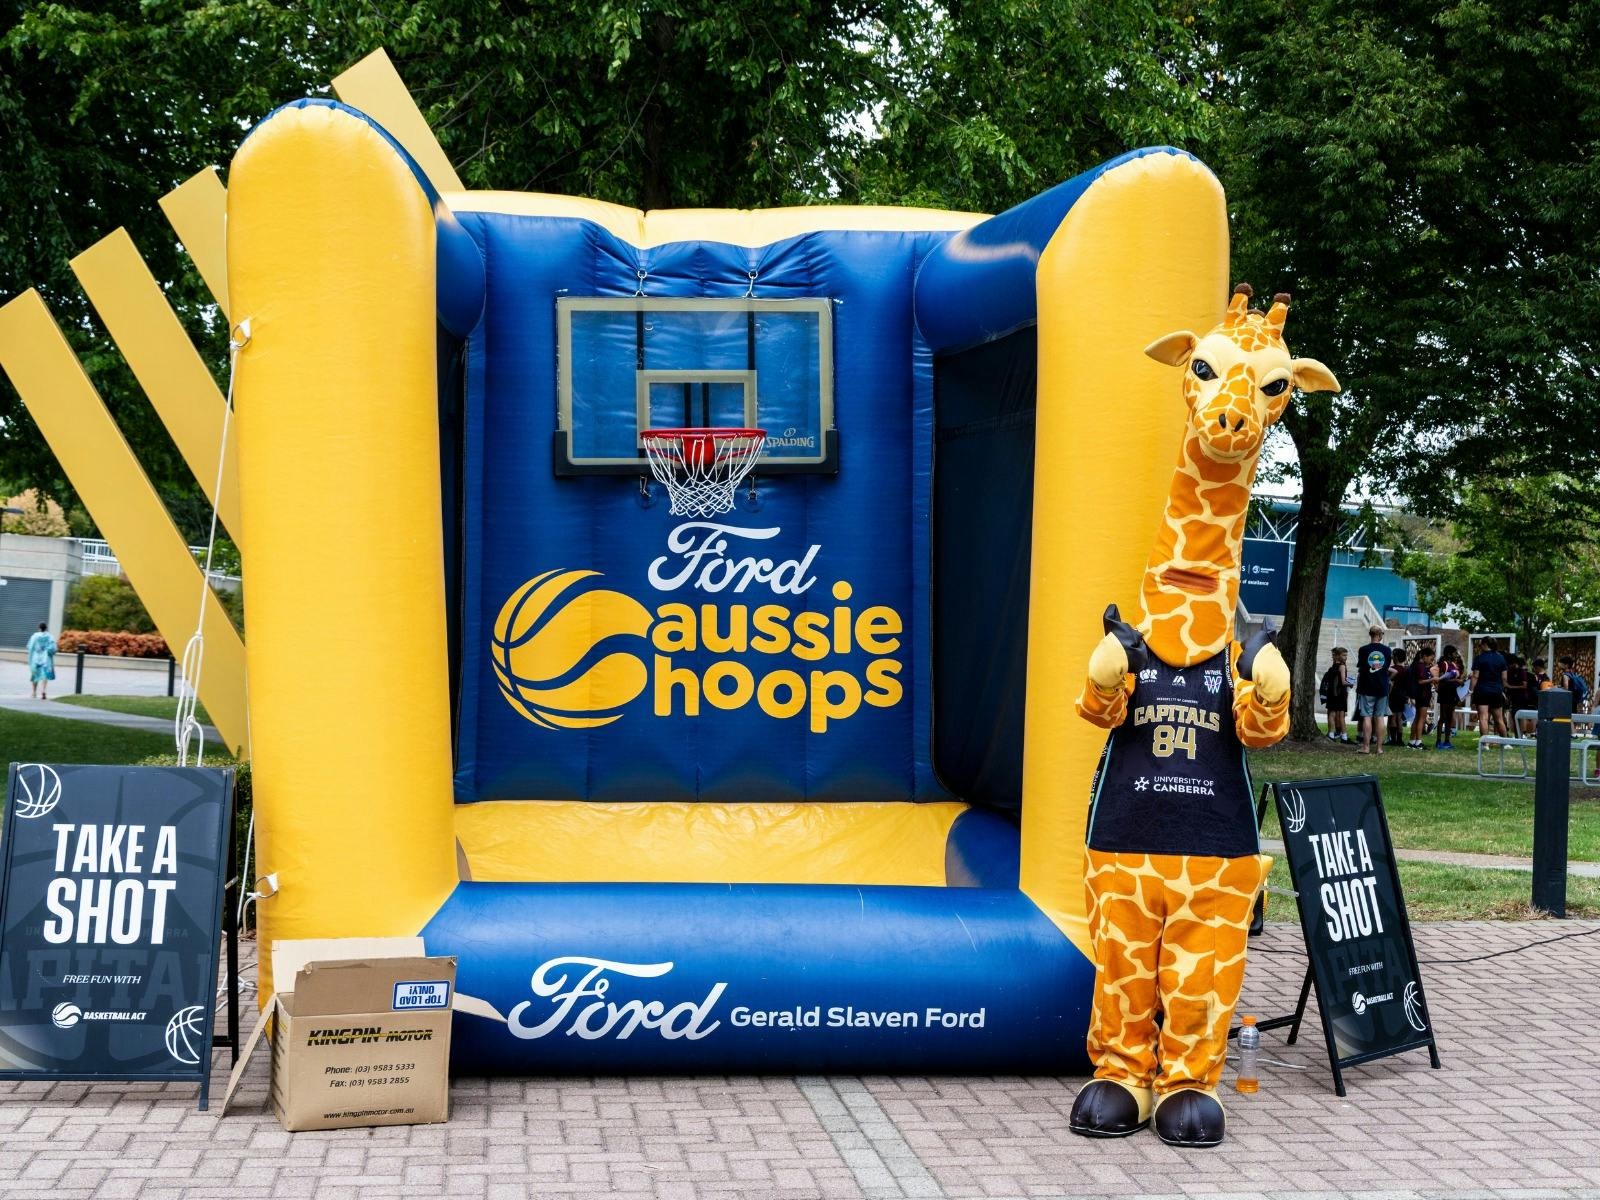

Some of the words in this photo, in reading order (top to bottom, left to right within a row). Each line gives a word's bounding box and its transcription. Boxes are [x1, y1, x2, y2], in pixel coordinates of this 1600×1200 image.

[766, 436, 815, 448] SPALDING
[647, 521, 822, 595] Ford
[651, 580, 904, 661] aussie
[653, 653, 903, 734] hoops
[1134, 704, 1220, 732] CAPITALS
[1152, 724, 1197, 760] 84
[1153, 776, 1202, 785] UNIVERSITY
[1203, 779, 1214, 787] OF
[1153, 783, 1215, 796] CANBERRA
[53, 823, 146, 874] TAKE
[152, 825, 177, 874] A
[1308, 831, 1359, 879] TAKE
[1356, 829, 1374, 872] A
[43, 878, 177, 945] SHOT
[1320, 876, 1385, 942] SHOT
[1348, 966, 1361, 976] FREE
[62, 975, 90, 984] FREE
[90, 975, 113, 984] FUN
[113, 975, 141, 984] WITH
[409, 985, 435, 995] ONLY!
[506, 956, 728, 1040] Ford
[399, 996, 422, 1005] LOAD
[424, 994, 442, 1004] TOP
[83, 1011, 130, 1020] BASKETBALL
[130, 1012, 147, 1020] ACT
[730, 1005, 819, 1027] Gerald
[827, 1005, 917, 1028] Slaven
[925, 1008, 986, 1028] Ford
[307, 1027, 382, 1047] KINGPIN
[385, 1029, 433, 1042] MOTOR
[325, 1066, 353, 1074] Phone:
[355, 1064, 370, 1074] (03)
[373, 1064, 393, 1072] 9583
[395, 1062, 415, 1071] 5333
[329, 1079, 347, 1088] Fax:
[349, 1078, 365, 1088] (03)
[367, 1077, 388, 1086] 9583
[389, 1076, 410, 1085] 2855
[323, 1107, 414, 1119] www.kingpinmotor.com.au
